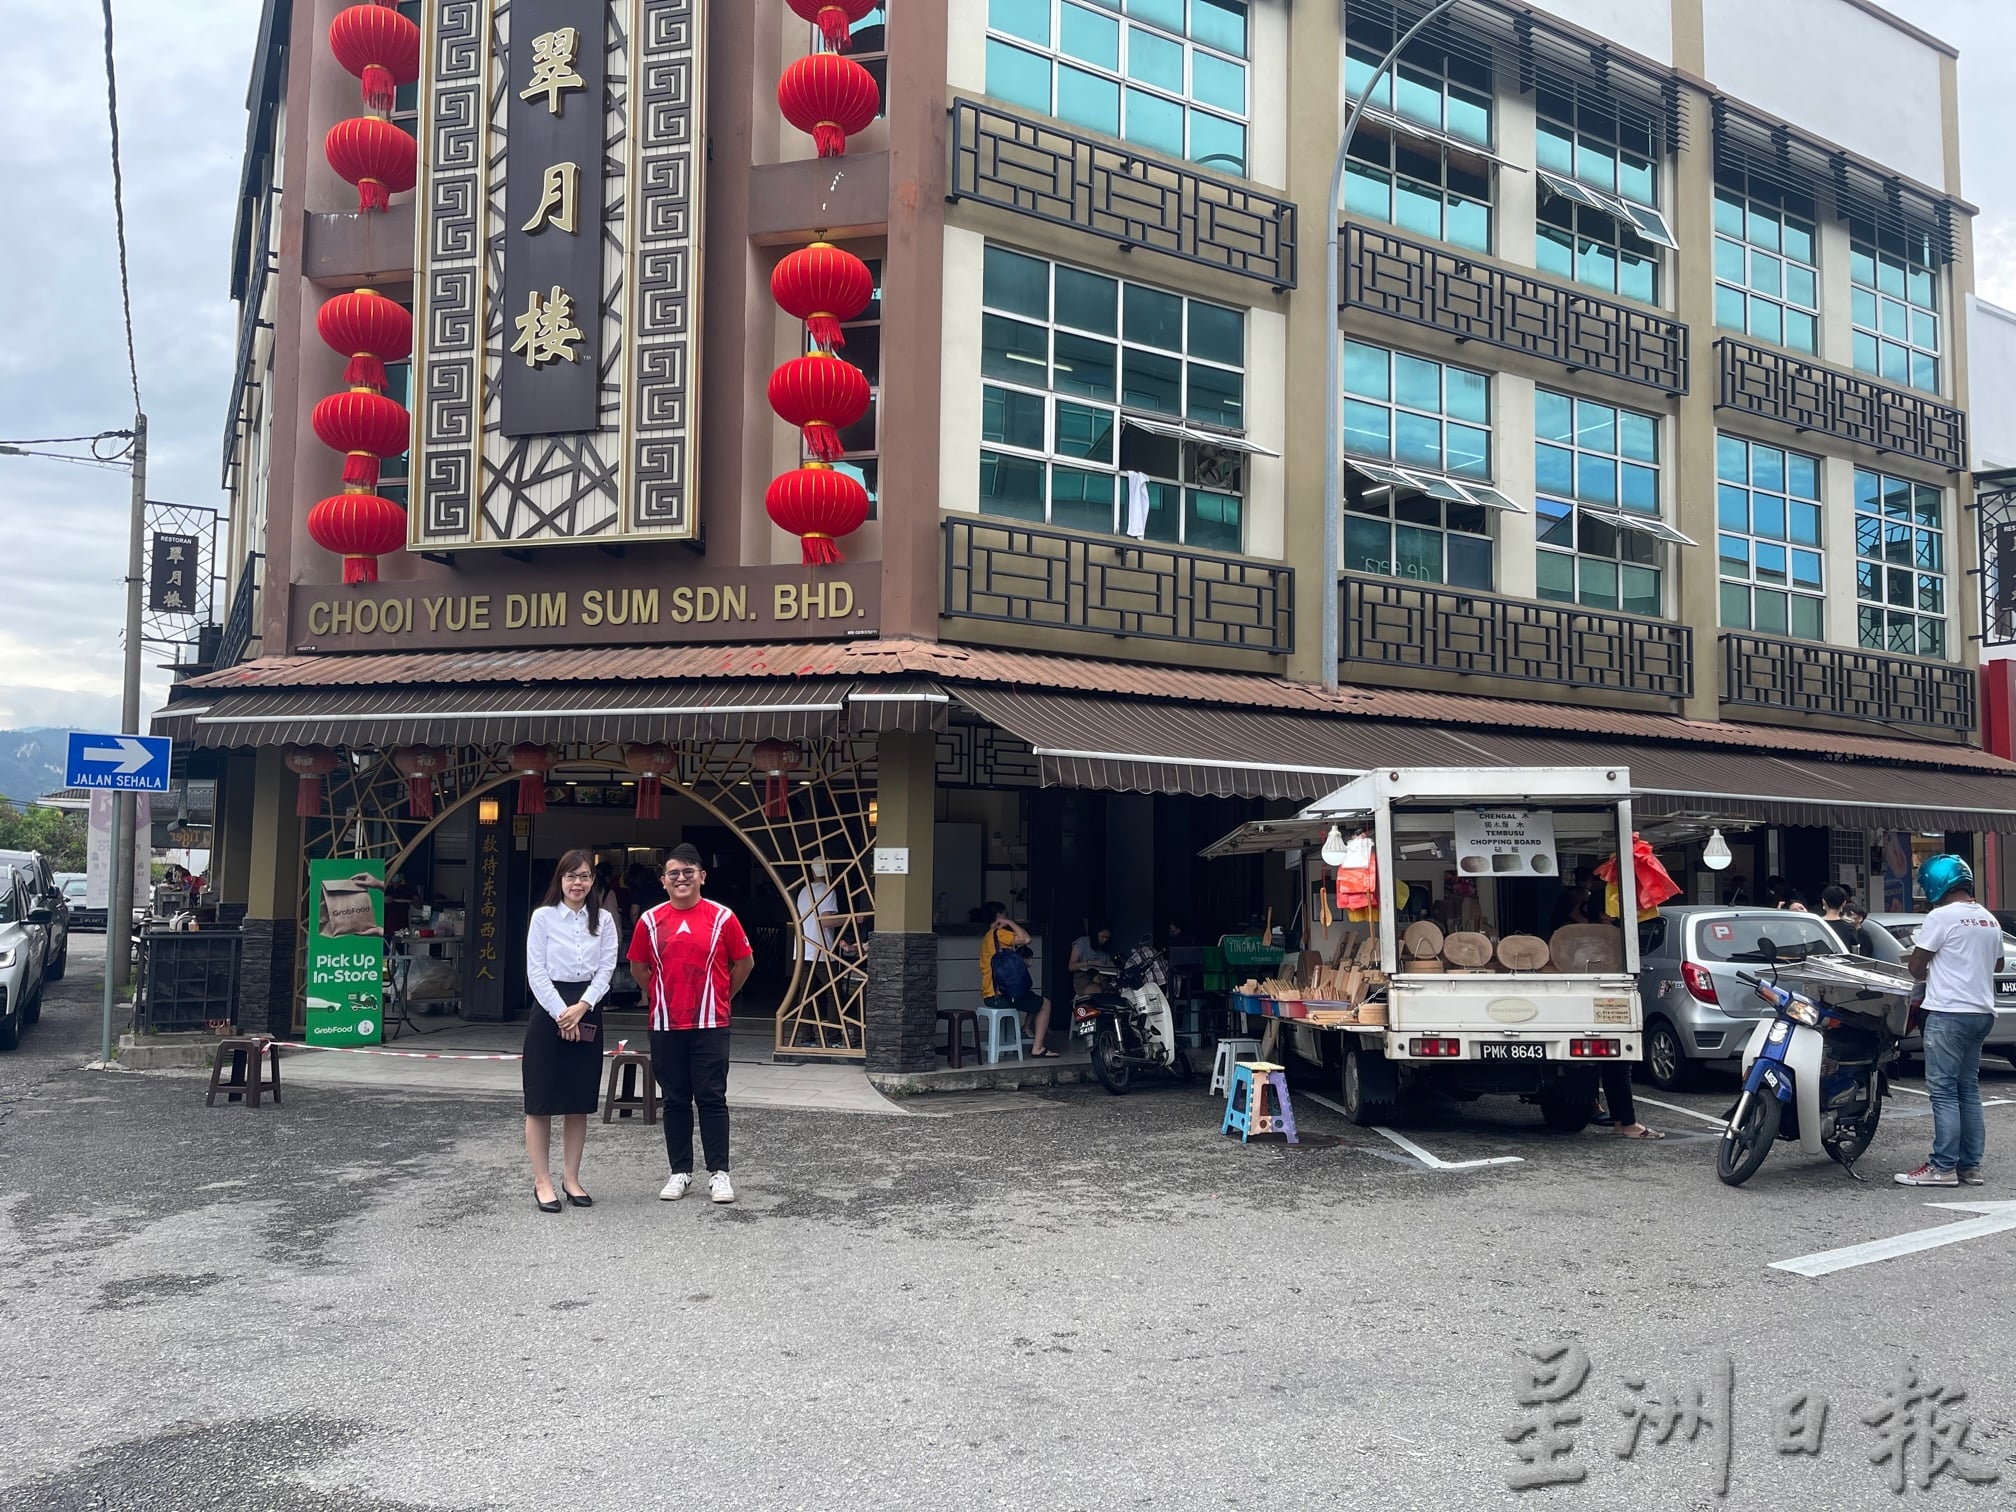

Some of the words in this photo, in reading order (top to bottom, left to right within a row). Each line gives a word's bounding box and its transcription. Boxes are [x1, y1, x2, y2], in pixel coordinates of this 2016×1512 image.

[510, 26, 584, 367] 翠月楼
[160, 535, 192, 545] RESTORAN
[163, 546, 185, 609] 翠月楼
[308, 597, 413, 636] CHOOI
[422, 595, 490, 632] YUE
[505, 592, 567, 630] DIM
[581, 588, 659, 627] SUM
[671, 585, 757, 623] SDN.
[774, 581, 865, 621] BHD.
[73, 773, 112, 786] JALAN
[116, 775, 162, 788] SEHALA
[332, 906, 370, 917] GrabFood
[477, 834, 498, 981] 款待东南西北人
[1714, 926, 1731, 938] P
[1229, 941, 1260, 953] TINGKAT
[316, 954, 349, 969] Pick
[353, 954, 375, 970] Up
[313, 969, 378, 984] In-Store
[314, 1025, 353, 1035] GrabFood
[1483, 1045, 1508, 1059] PMK
[1511, 1045, 1543, 1059] 8643
